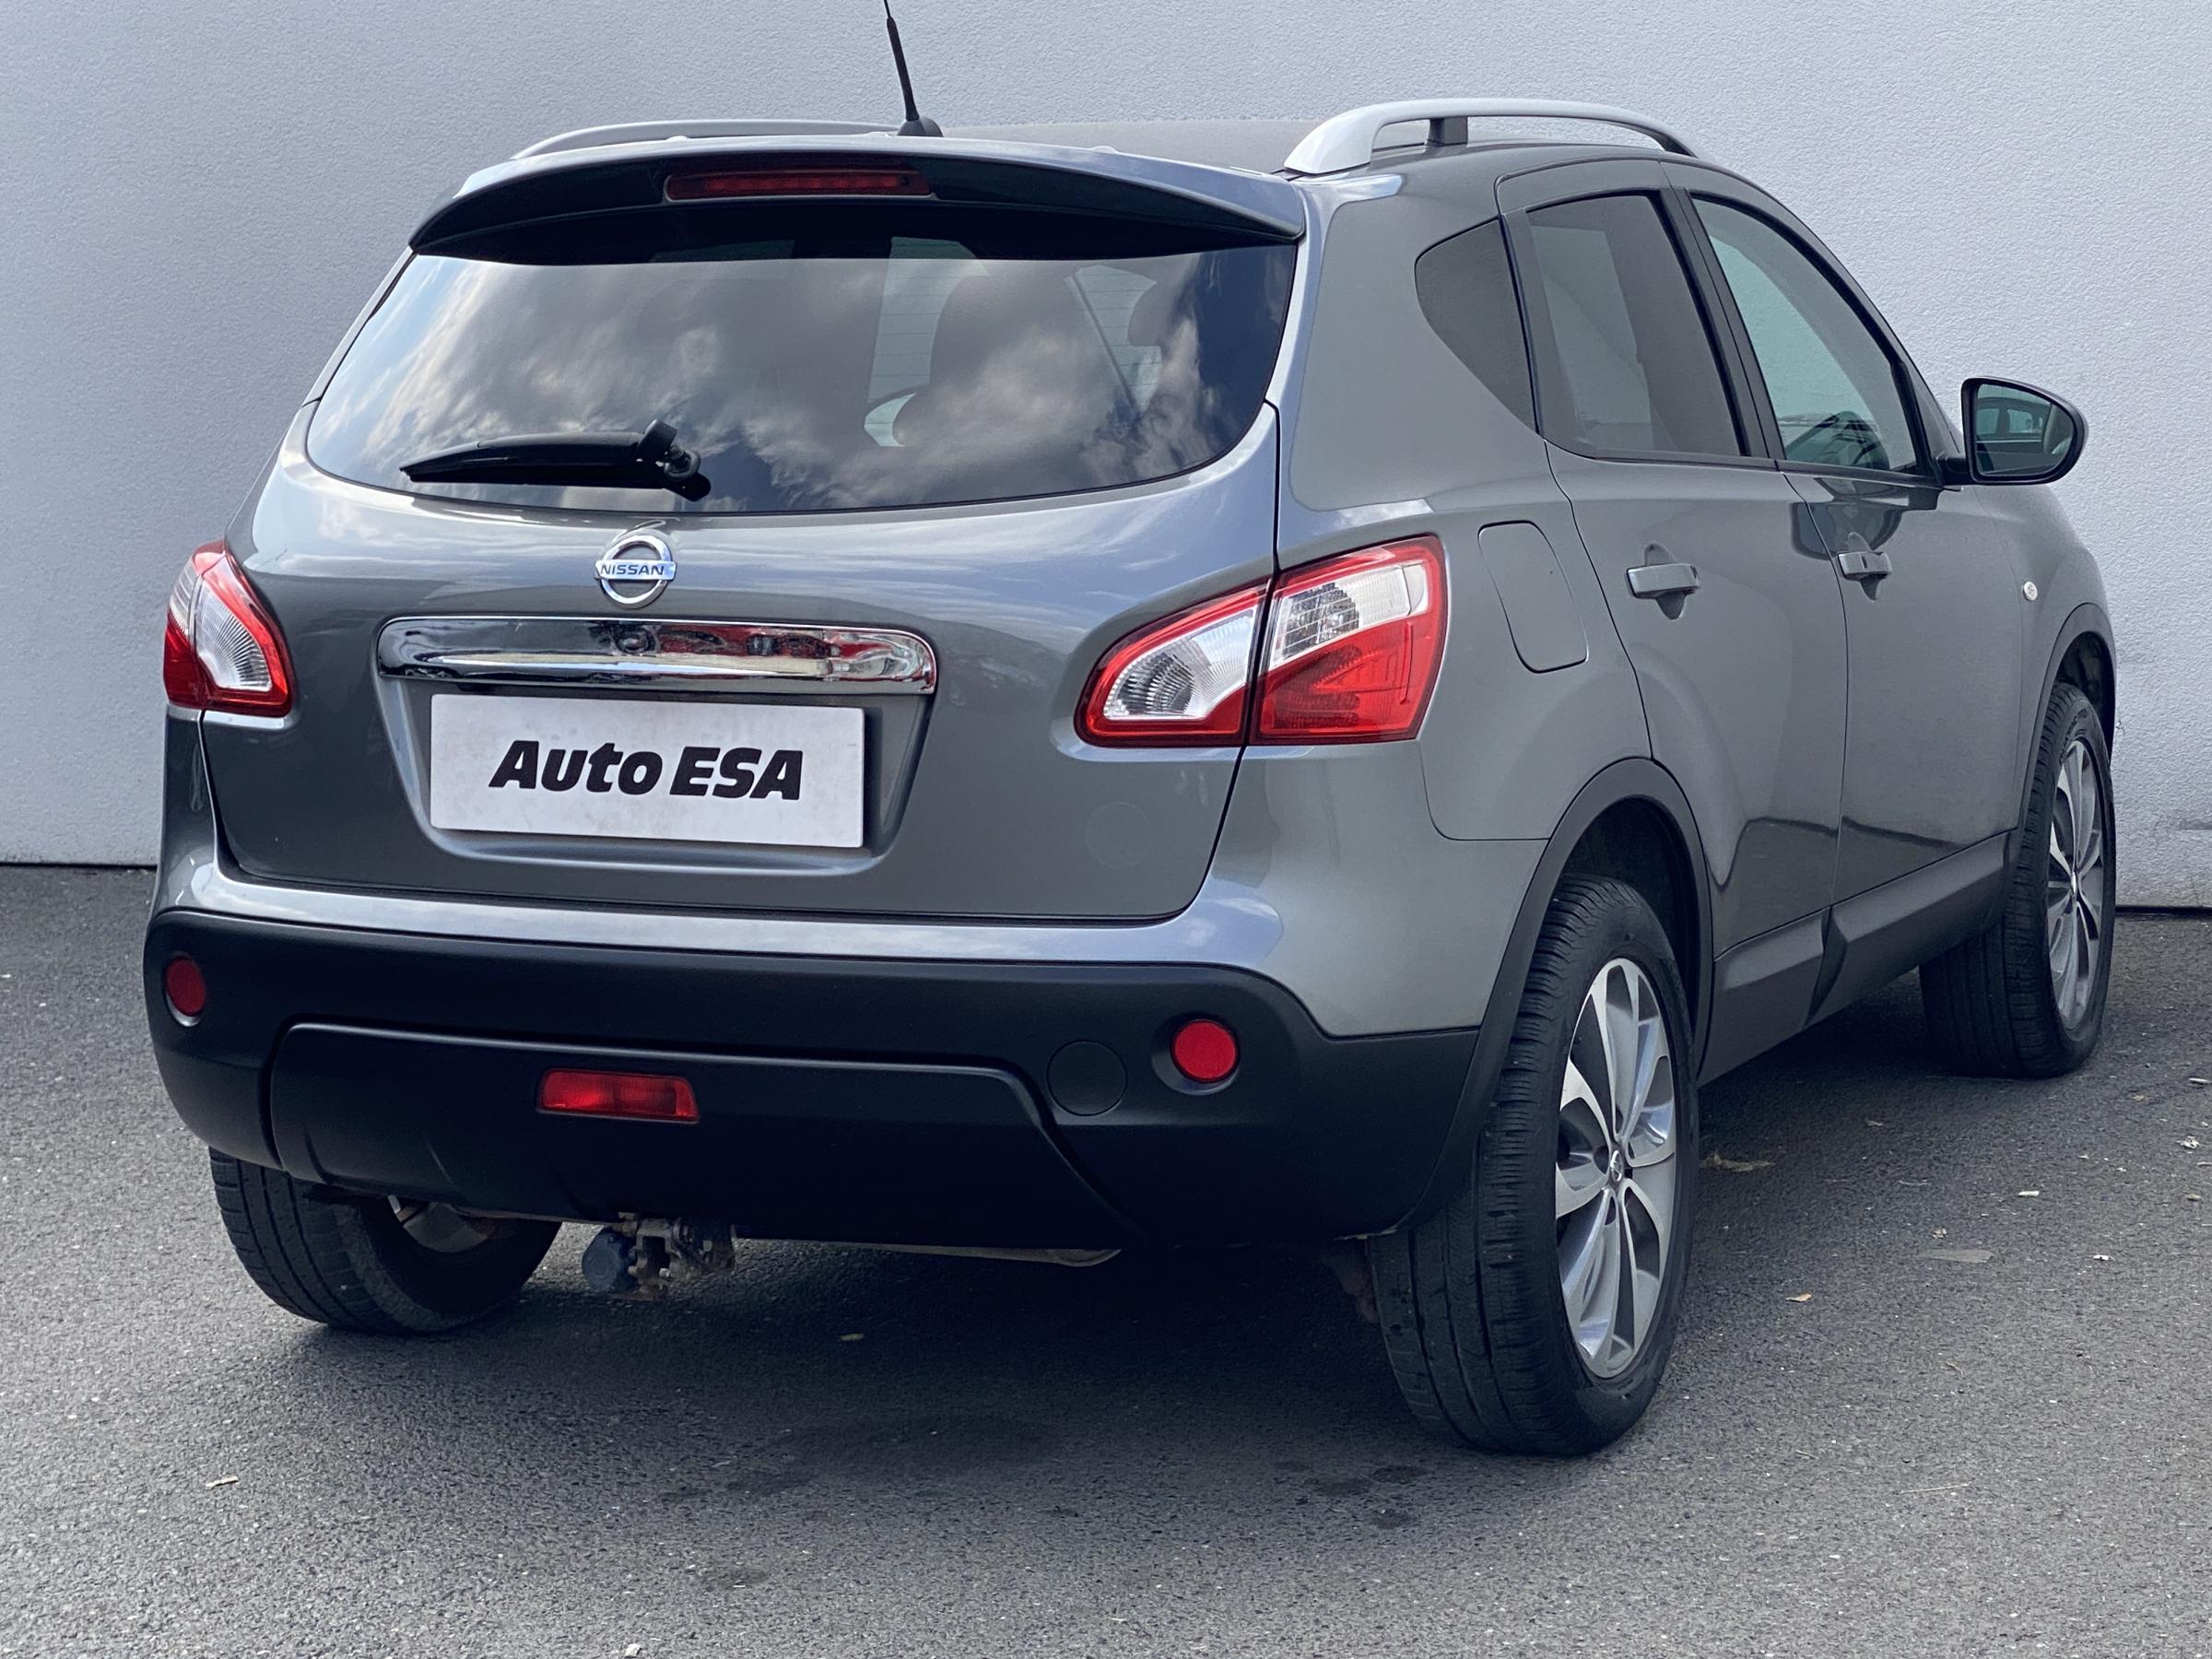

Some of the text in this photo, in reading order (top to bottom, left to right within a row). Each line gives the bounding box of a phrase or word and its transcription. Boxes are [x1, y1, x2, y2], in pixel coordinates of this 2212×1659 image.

[600, 564, 665, 576] NISSAN
[488, 740, 803, 800] Auto ESA
